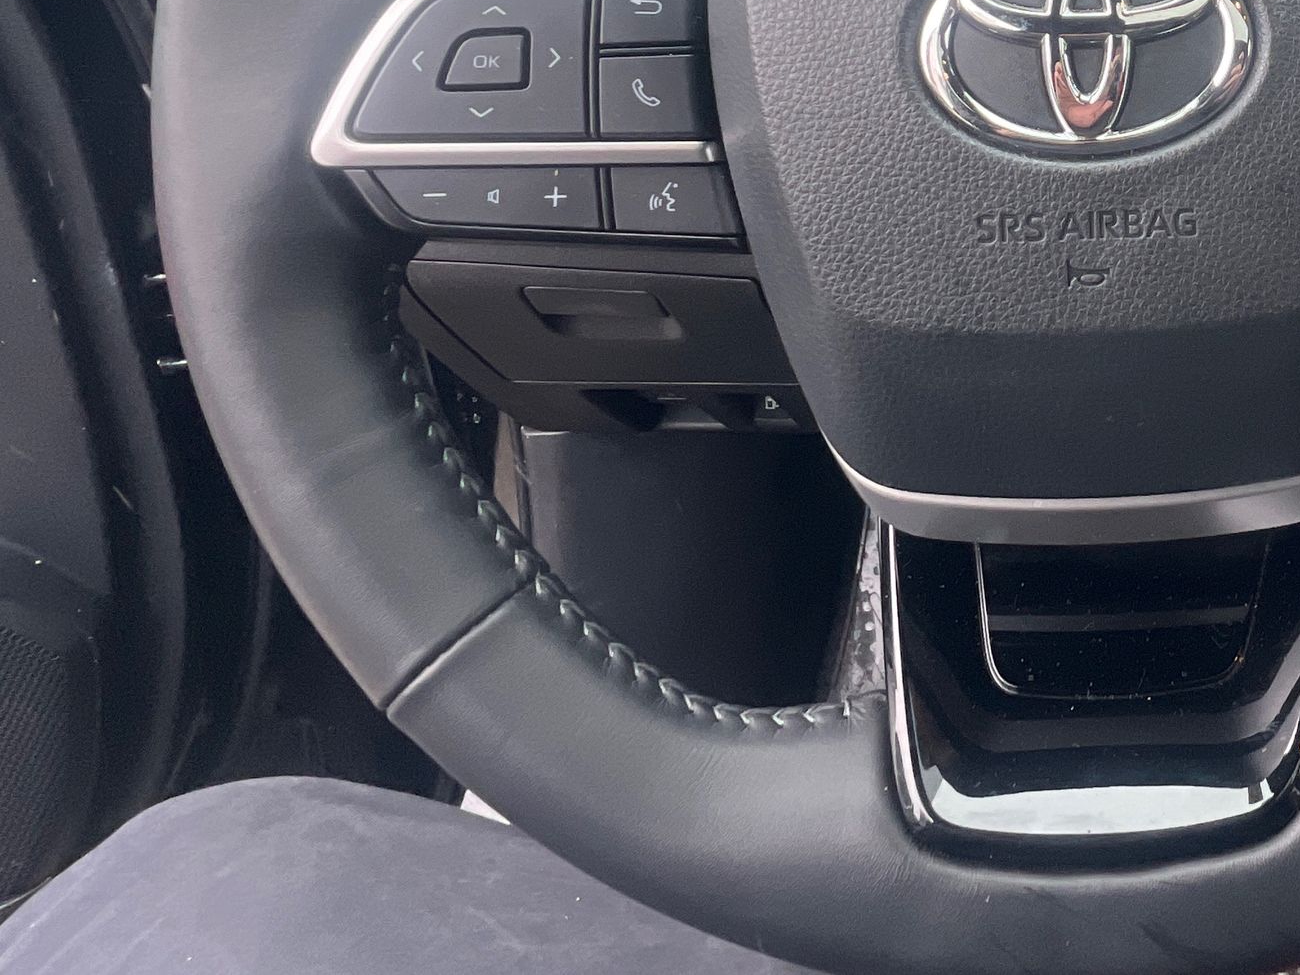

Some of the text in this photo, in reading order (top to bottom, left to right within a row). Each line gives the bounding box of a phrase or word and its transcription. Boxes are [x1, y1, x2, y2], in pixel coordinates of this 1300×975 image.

[473, 55, 500, 68] OK
[976, 207, 1200, 245] SRS AIRBAG
